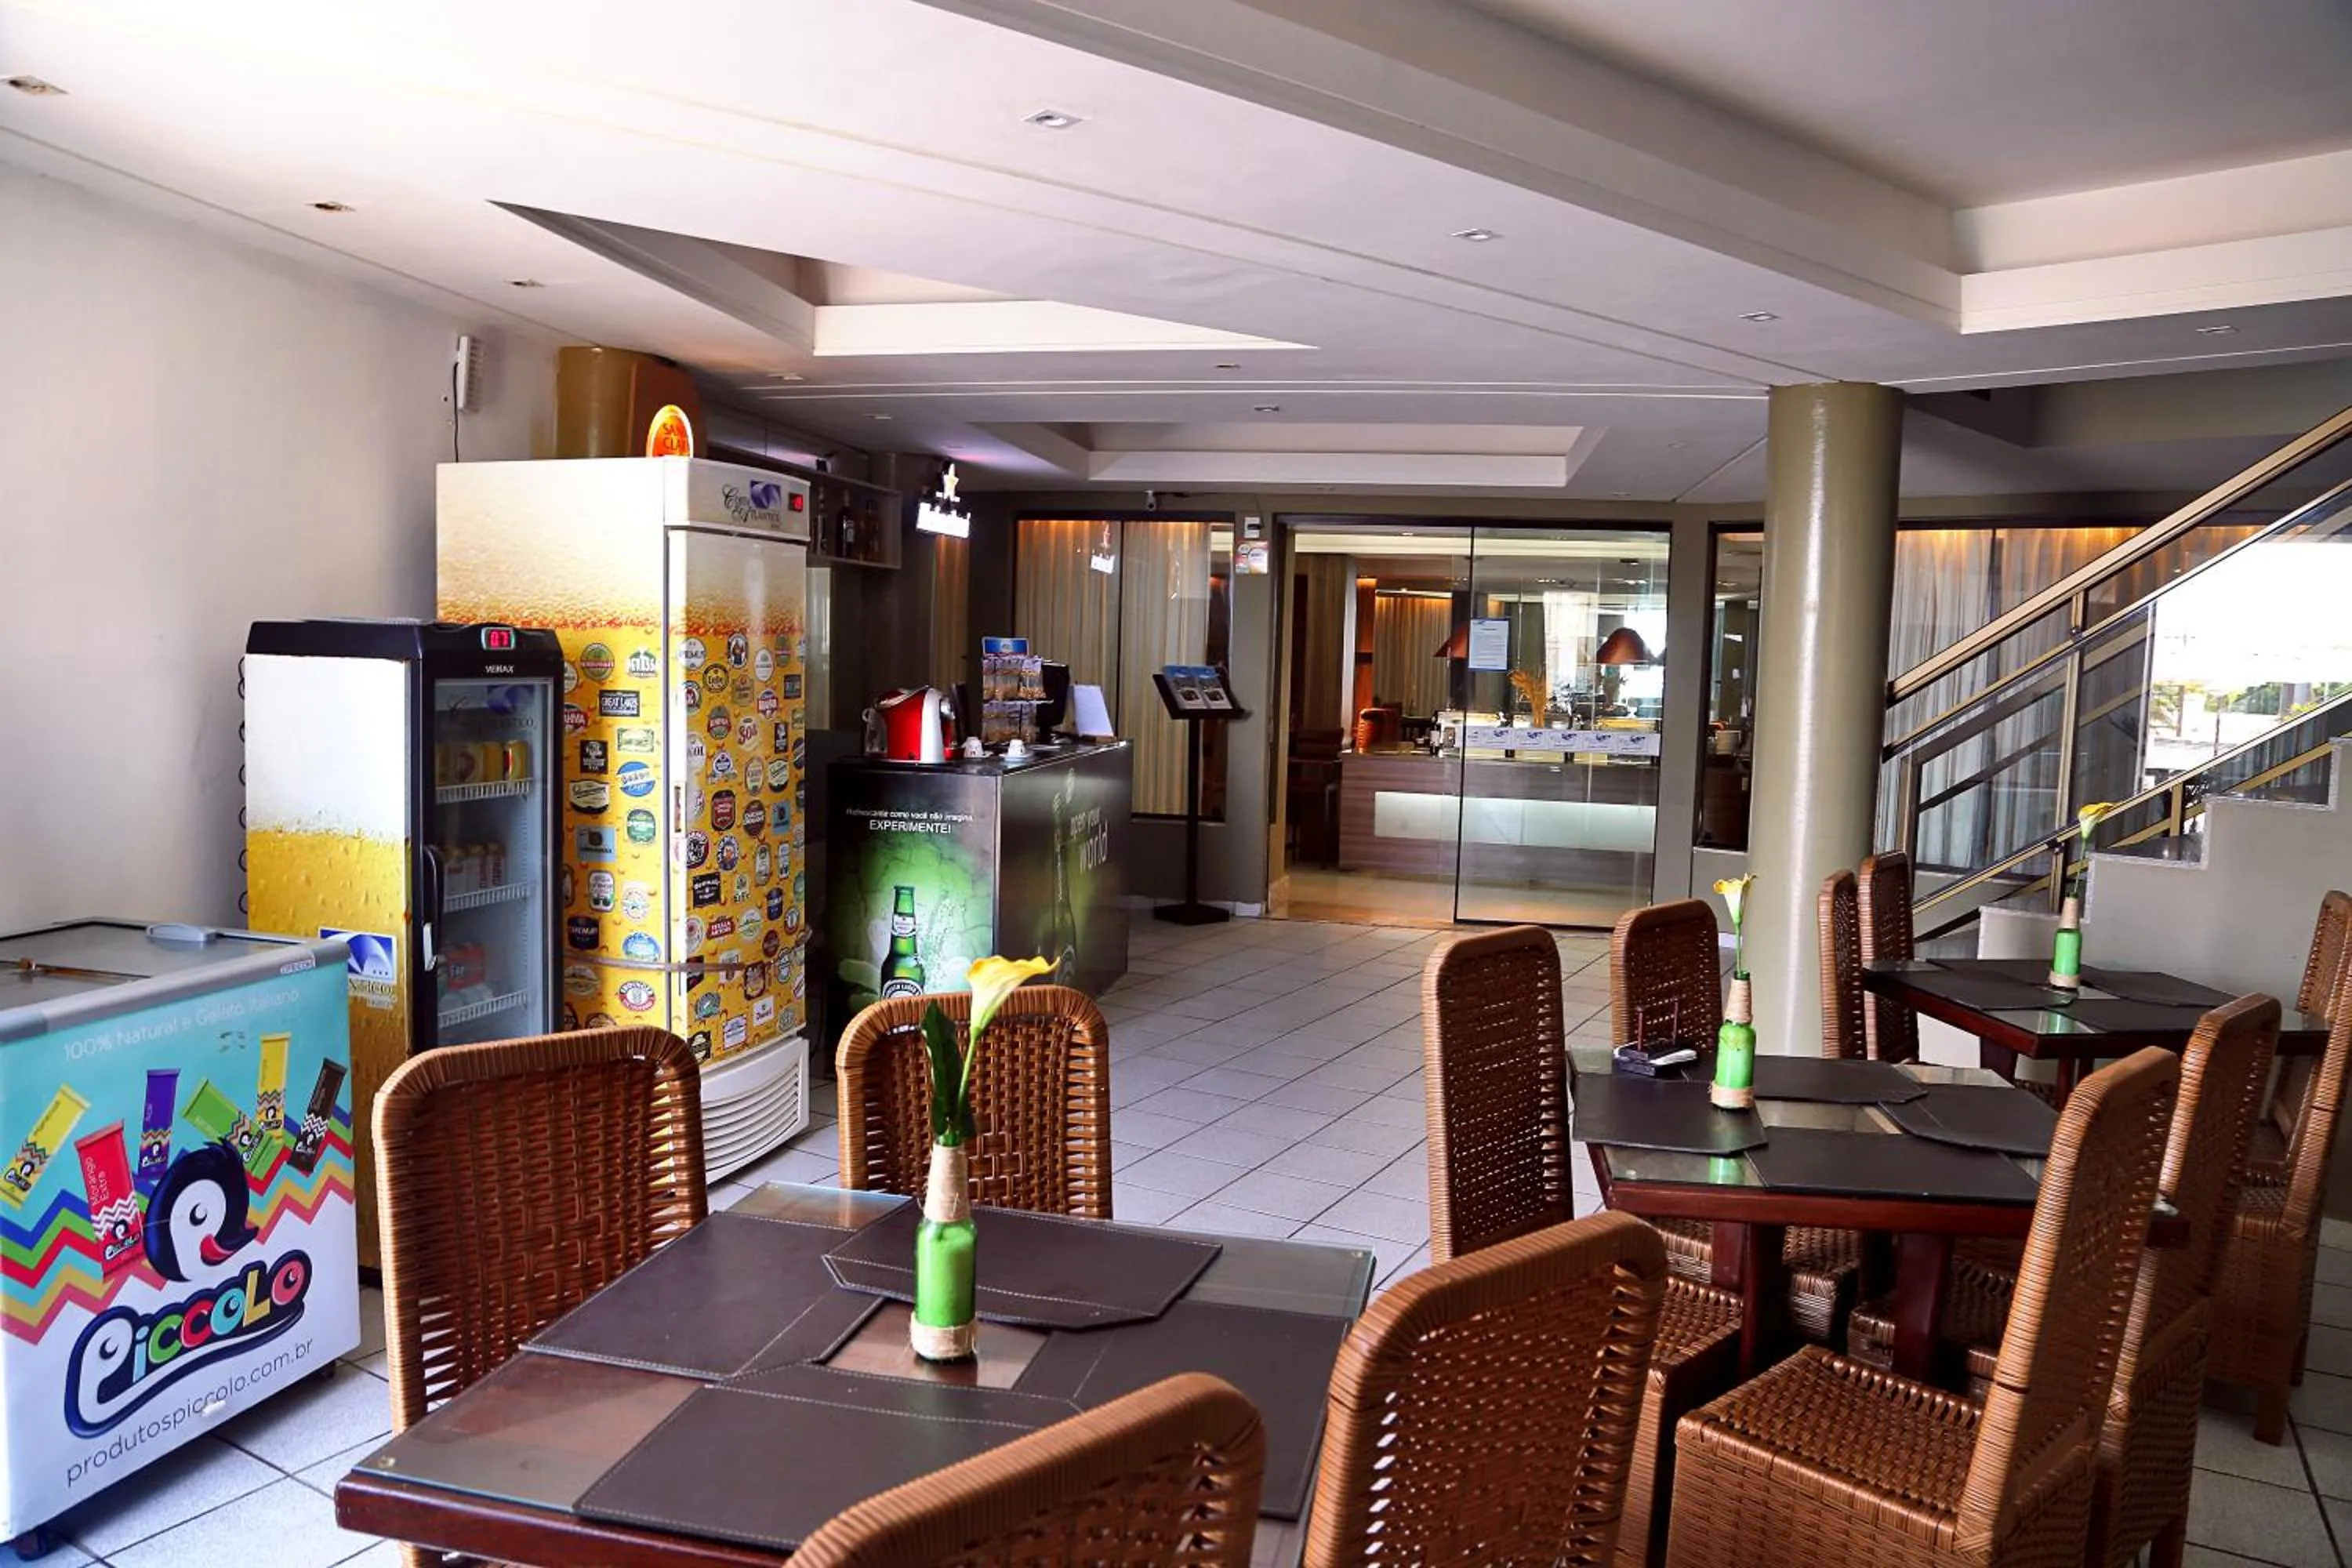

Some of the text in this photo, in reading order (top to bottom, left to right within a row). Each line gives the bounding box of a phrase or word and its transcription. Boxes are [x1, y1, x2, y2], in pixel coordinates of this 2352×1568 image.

[869, 819, 952, 834] EXPERIMENTE!
[1080, 818, 1108, 874] world
[64, 1034, 112, 1061] 100%
[117, 1017, 177, 1045] Natural
[67, 1338, 313, 1487] produtospiccolo.com.br
